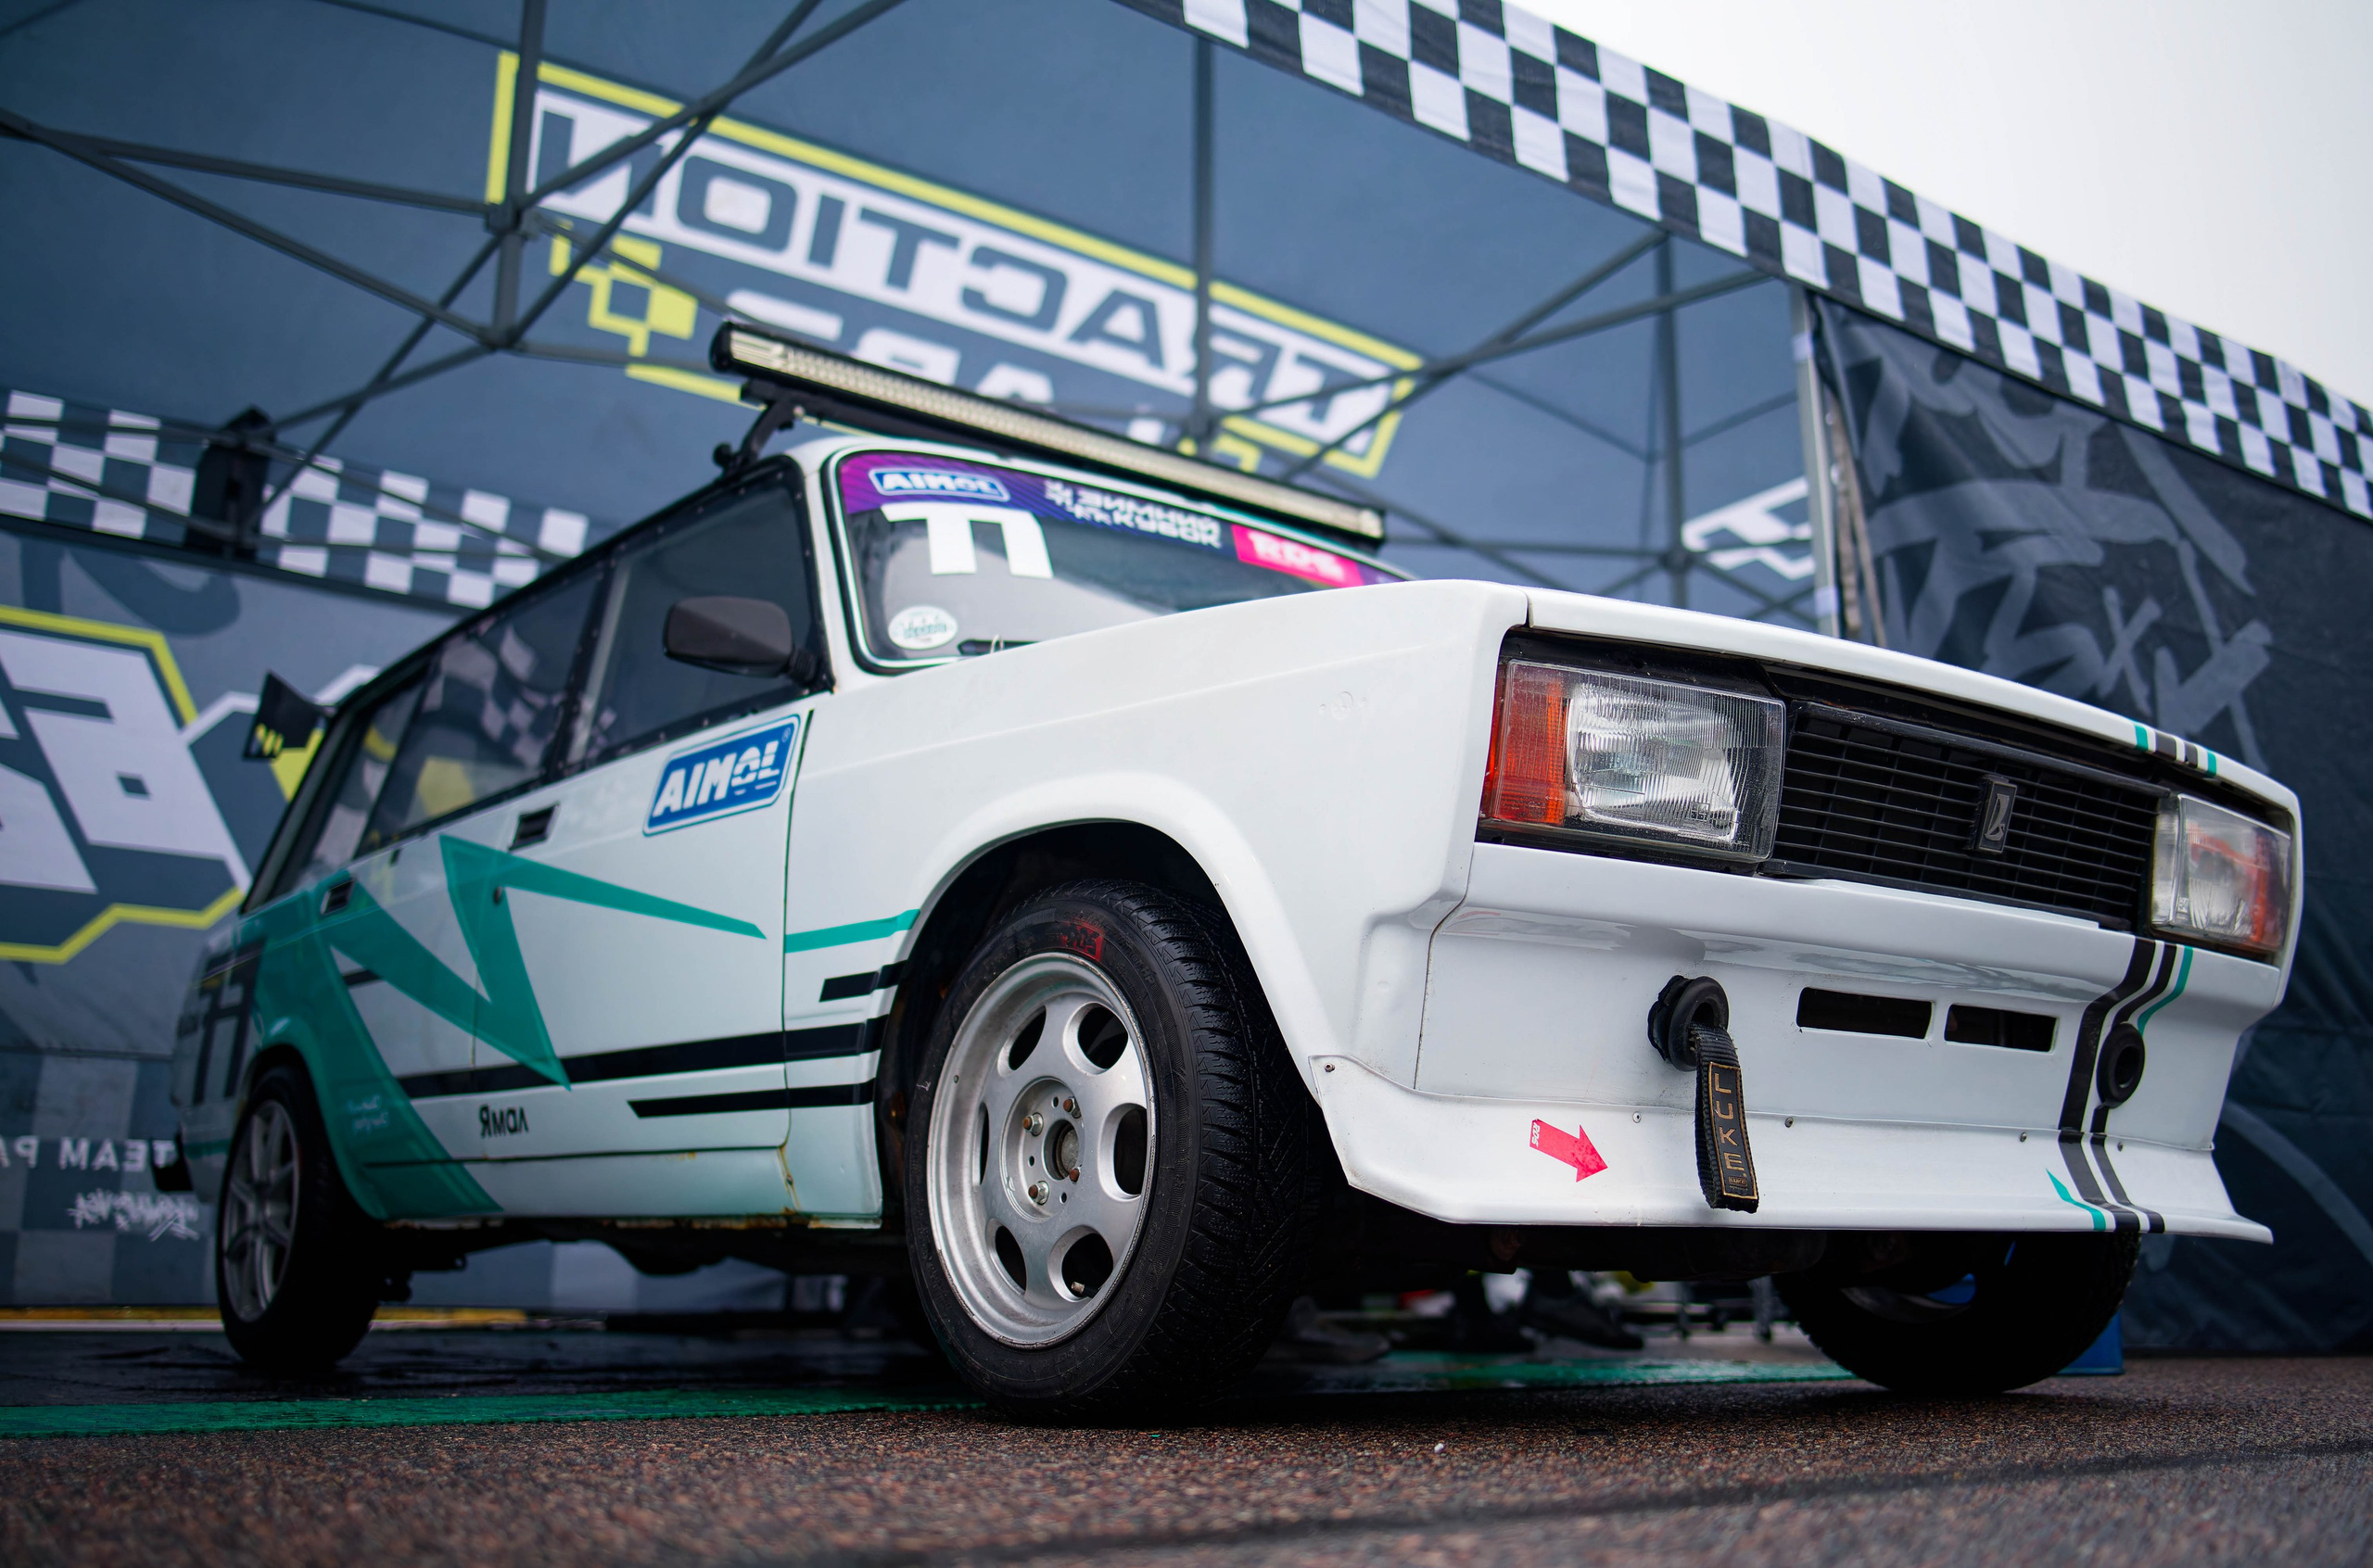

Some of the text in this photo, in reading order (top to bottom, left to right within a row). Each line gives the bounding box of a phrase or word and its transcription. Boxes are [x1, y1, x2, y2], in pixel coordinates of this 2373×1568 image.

[652, 740, 780, 818] AIMOL
[1530, 1121, 1541, 1148] RDS
[1715, 1072, 1745, 1171] LUKE
